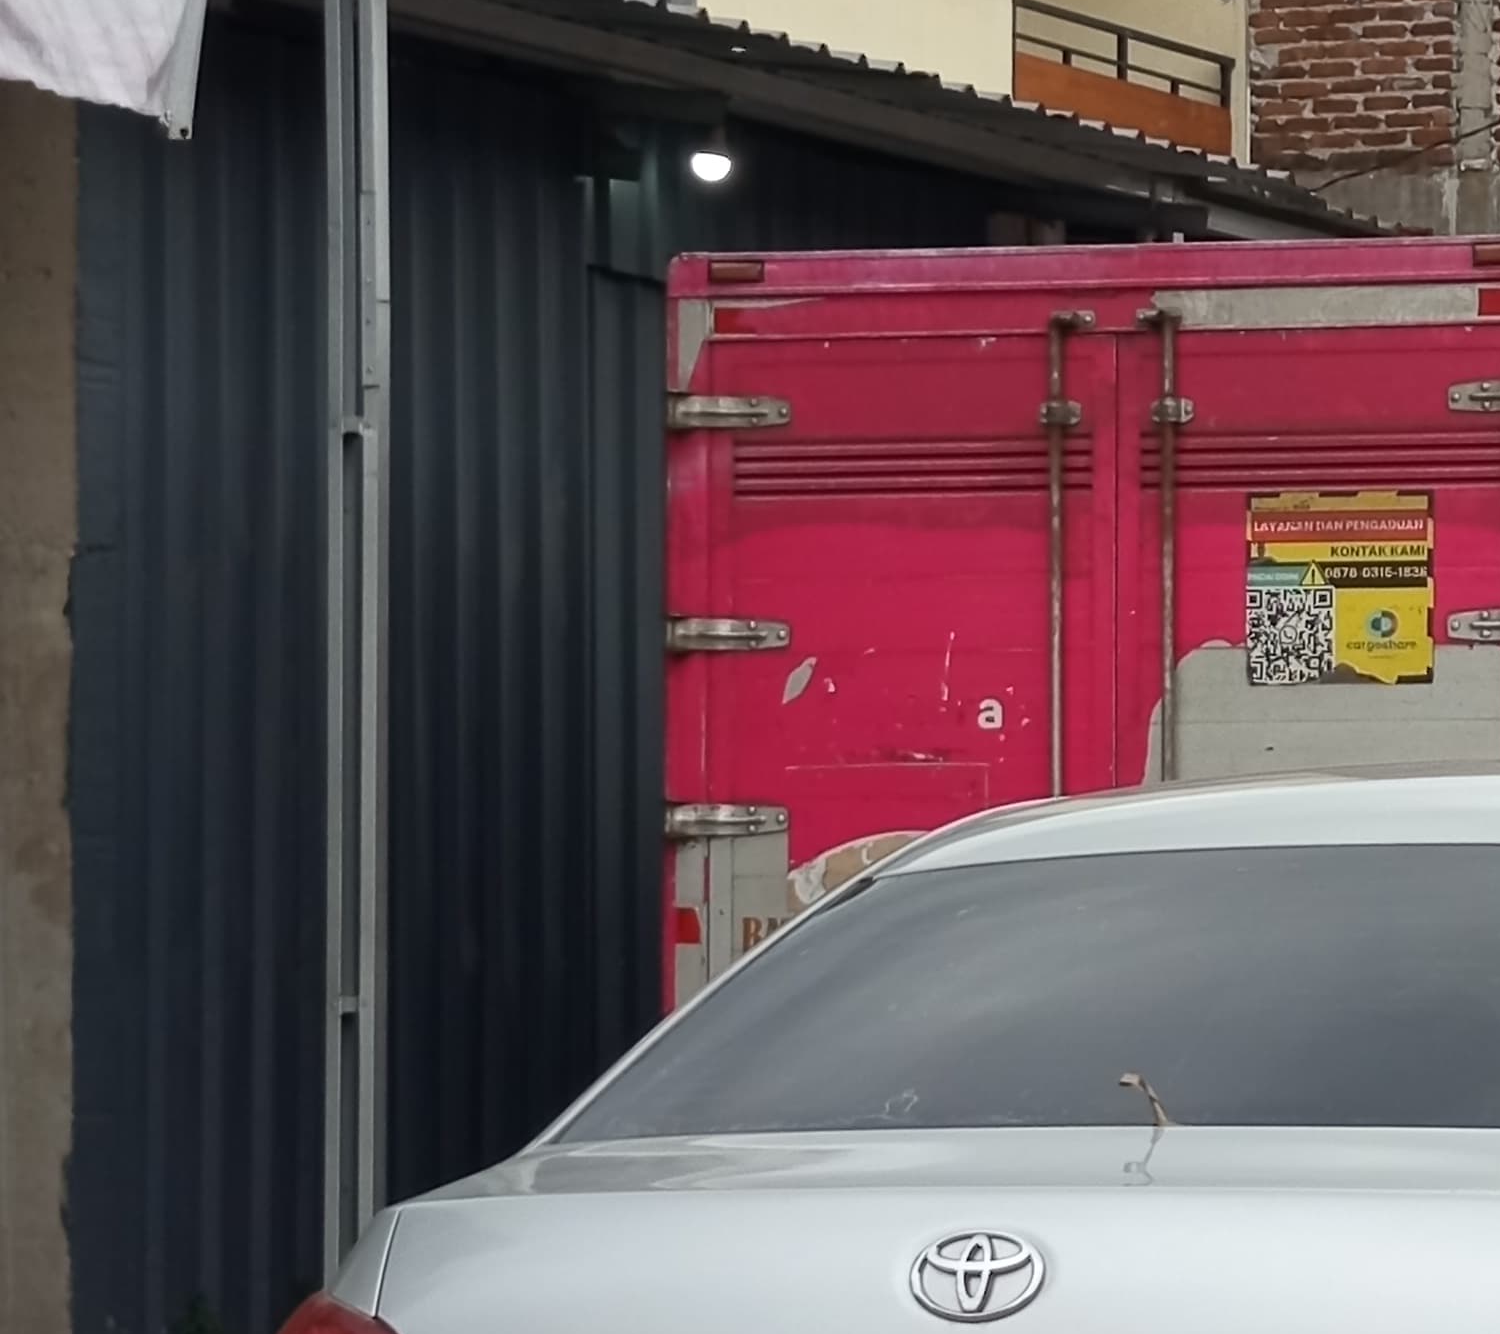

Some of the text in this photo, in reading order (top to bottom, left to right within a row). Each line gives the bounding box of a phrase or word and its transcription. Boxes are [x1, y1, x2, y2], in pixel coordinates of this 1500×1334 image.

[1316, 520, 1344, 532] DAN
[1347, 519, 1425, 531] PENGADUAN
[1331, 545, 1426, 558] KONTAK KAMI
